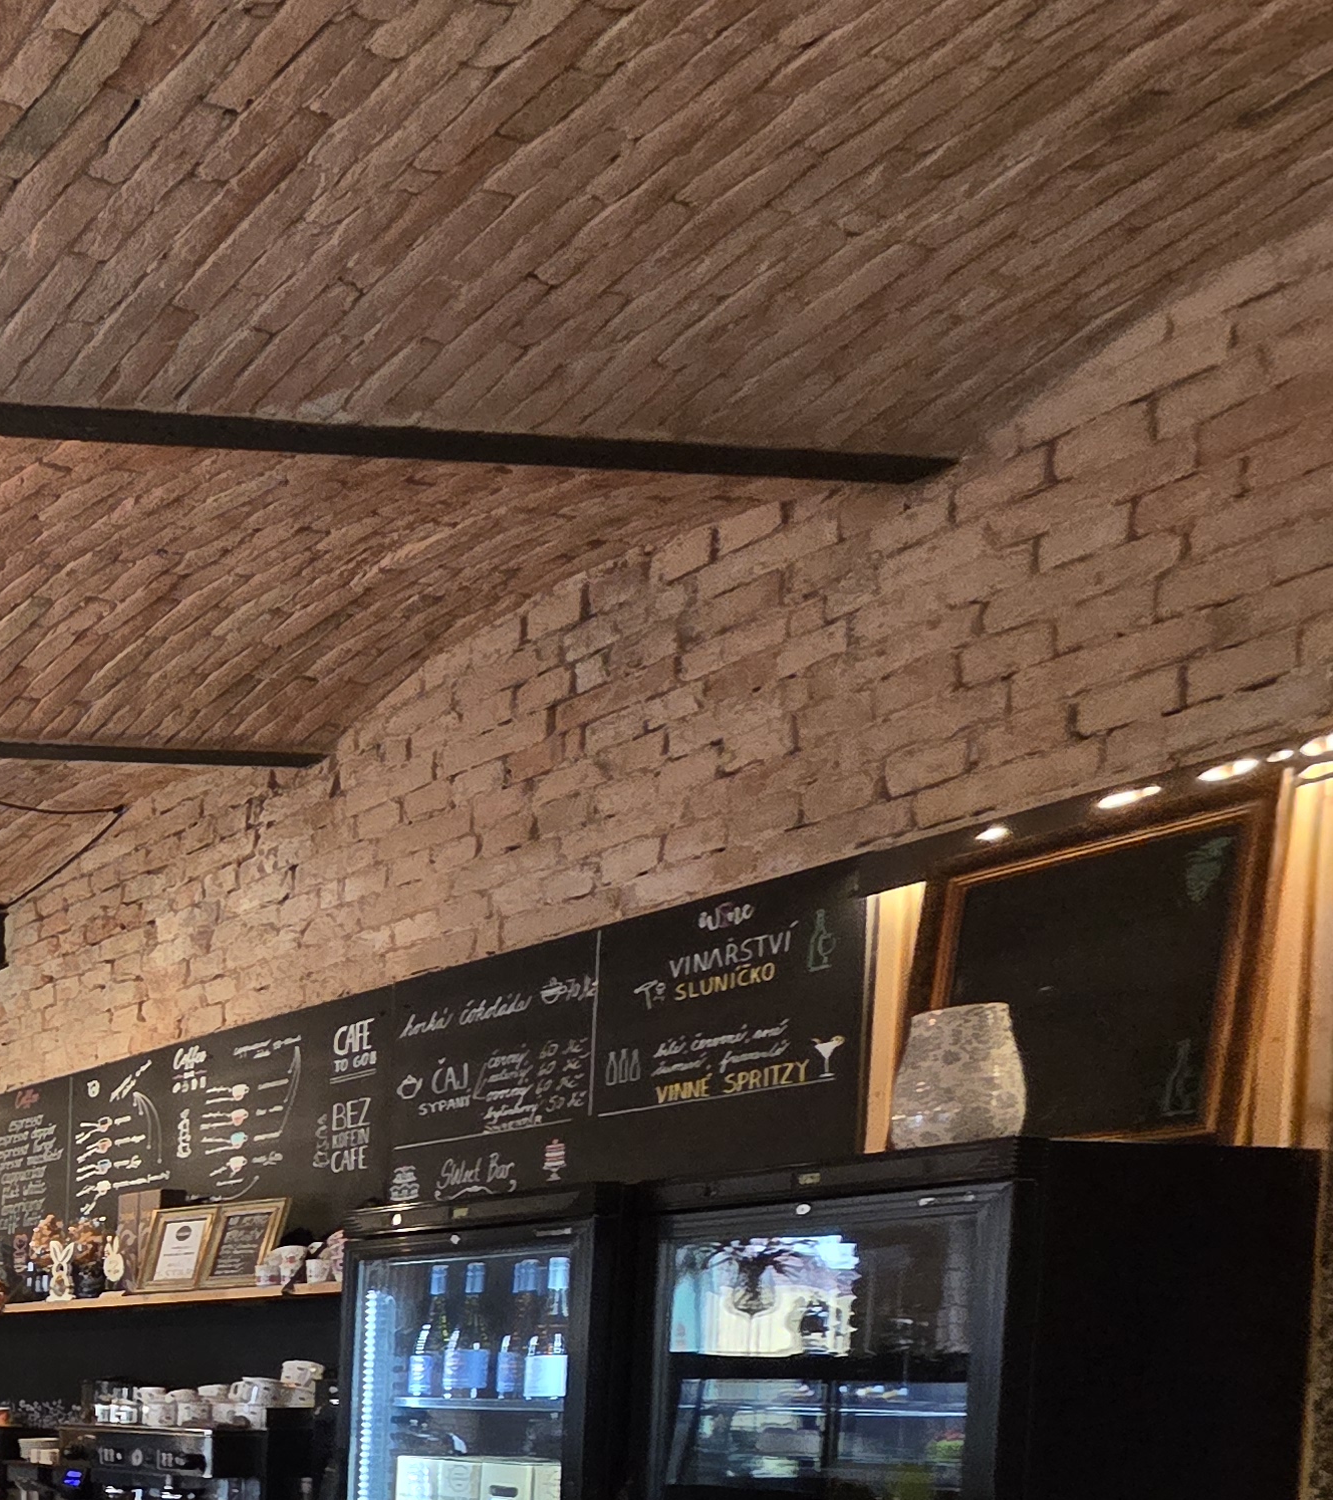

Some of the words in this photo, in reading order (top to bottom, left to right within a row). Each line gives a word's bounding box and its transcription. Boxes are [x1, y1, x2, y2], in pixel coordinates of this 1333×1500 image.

[669, 920, 799, 979] VINAŘSTVÍ
[334, 1059, 349, 1073] TO
[432, 1057, 469, 1094] ČAJ
[656, 1072, 713, 1104] VINNÉ
[723, 1058, 810, 1094] SPRITZY
[332, 1097, 371, 1131] BEZ
[331, 1145, 369, 1173] CAFE
